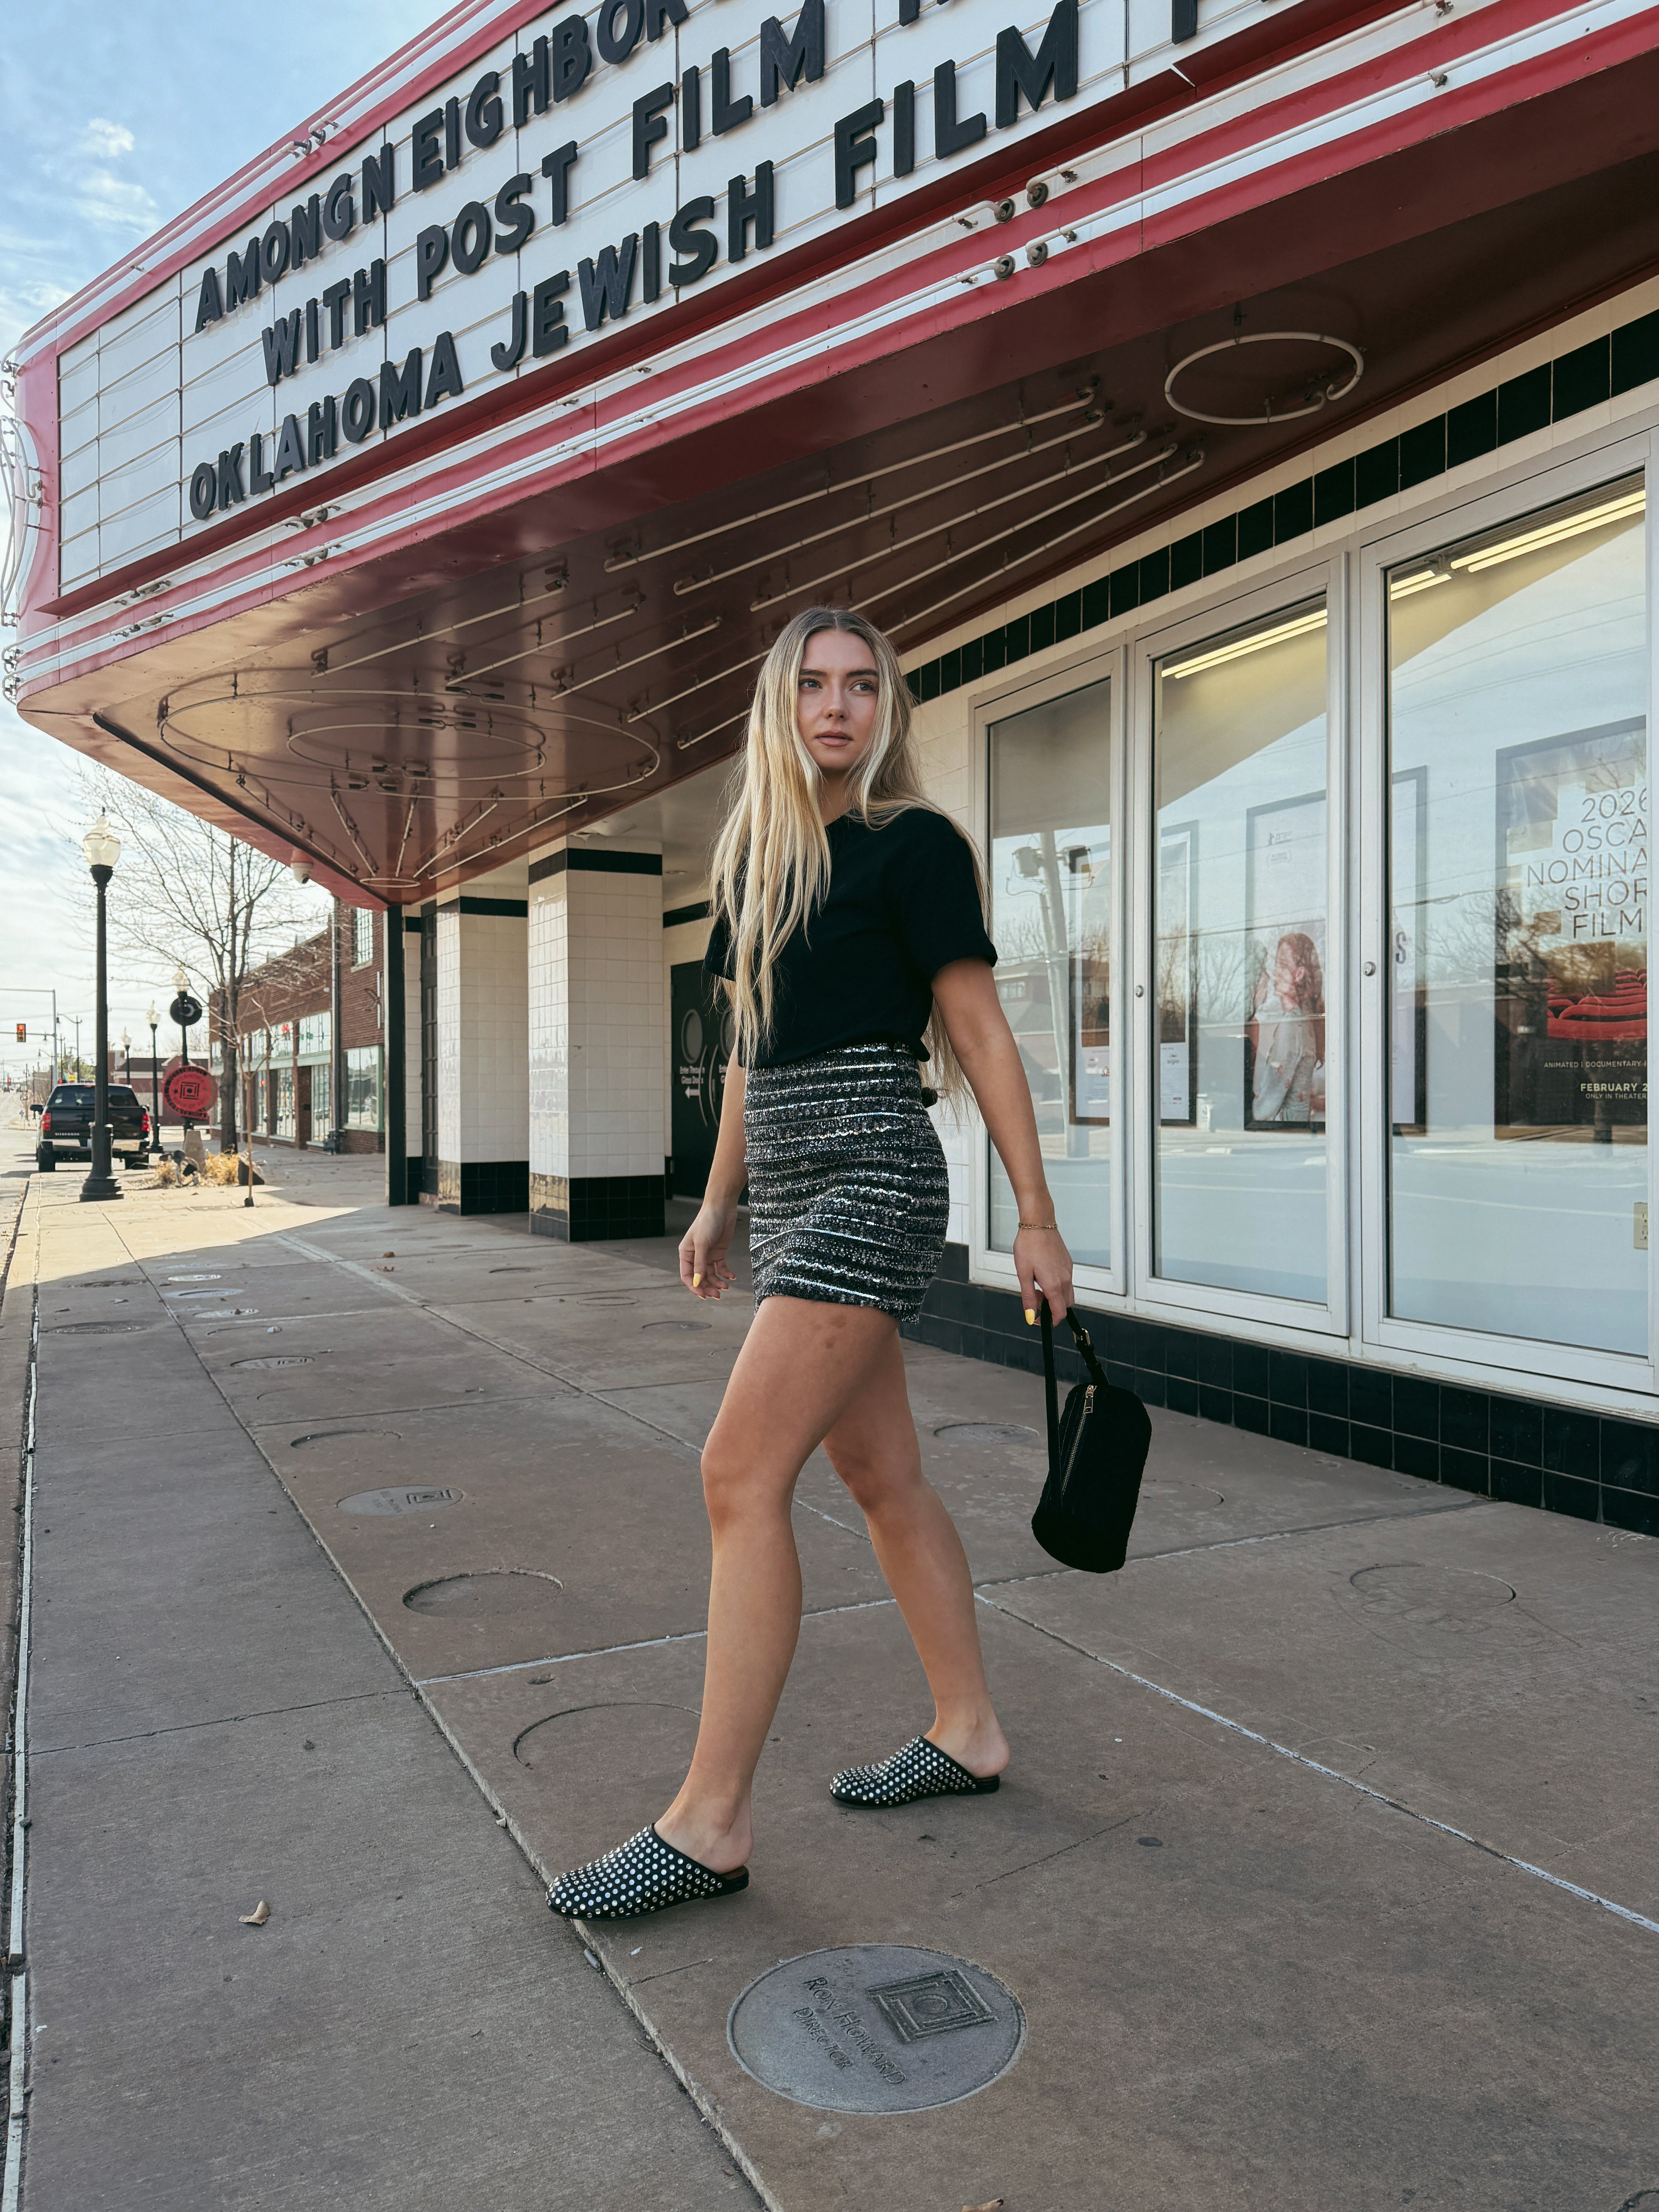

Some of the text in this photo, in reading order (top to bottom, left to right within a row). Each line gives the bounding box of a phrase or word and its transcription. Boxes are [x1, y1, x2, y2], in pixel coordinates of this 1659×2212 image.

[262, 0, 825, 386] WITH POST FILM
[190, 0, 1078, 520] OKLAHOMA JEWISH FILM
[1580, 1083, 1638, 1092] FEBRUARY
[793, 2006, 854, 2070] DIRECTOR
[802, 1977, 907, 2084] RON HOWARD
